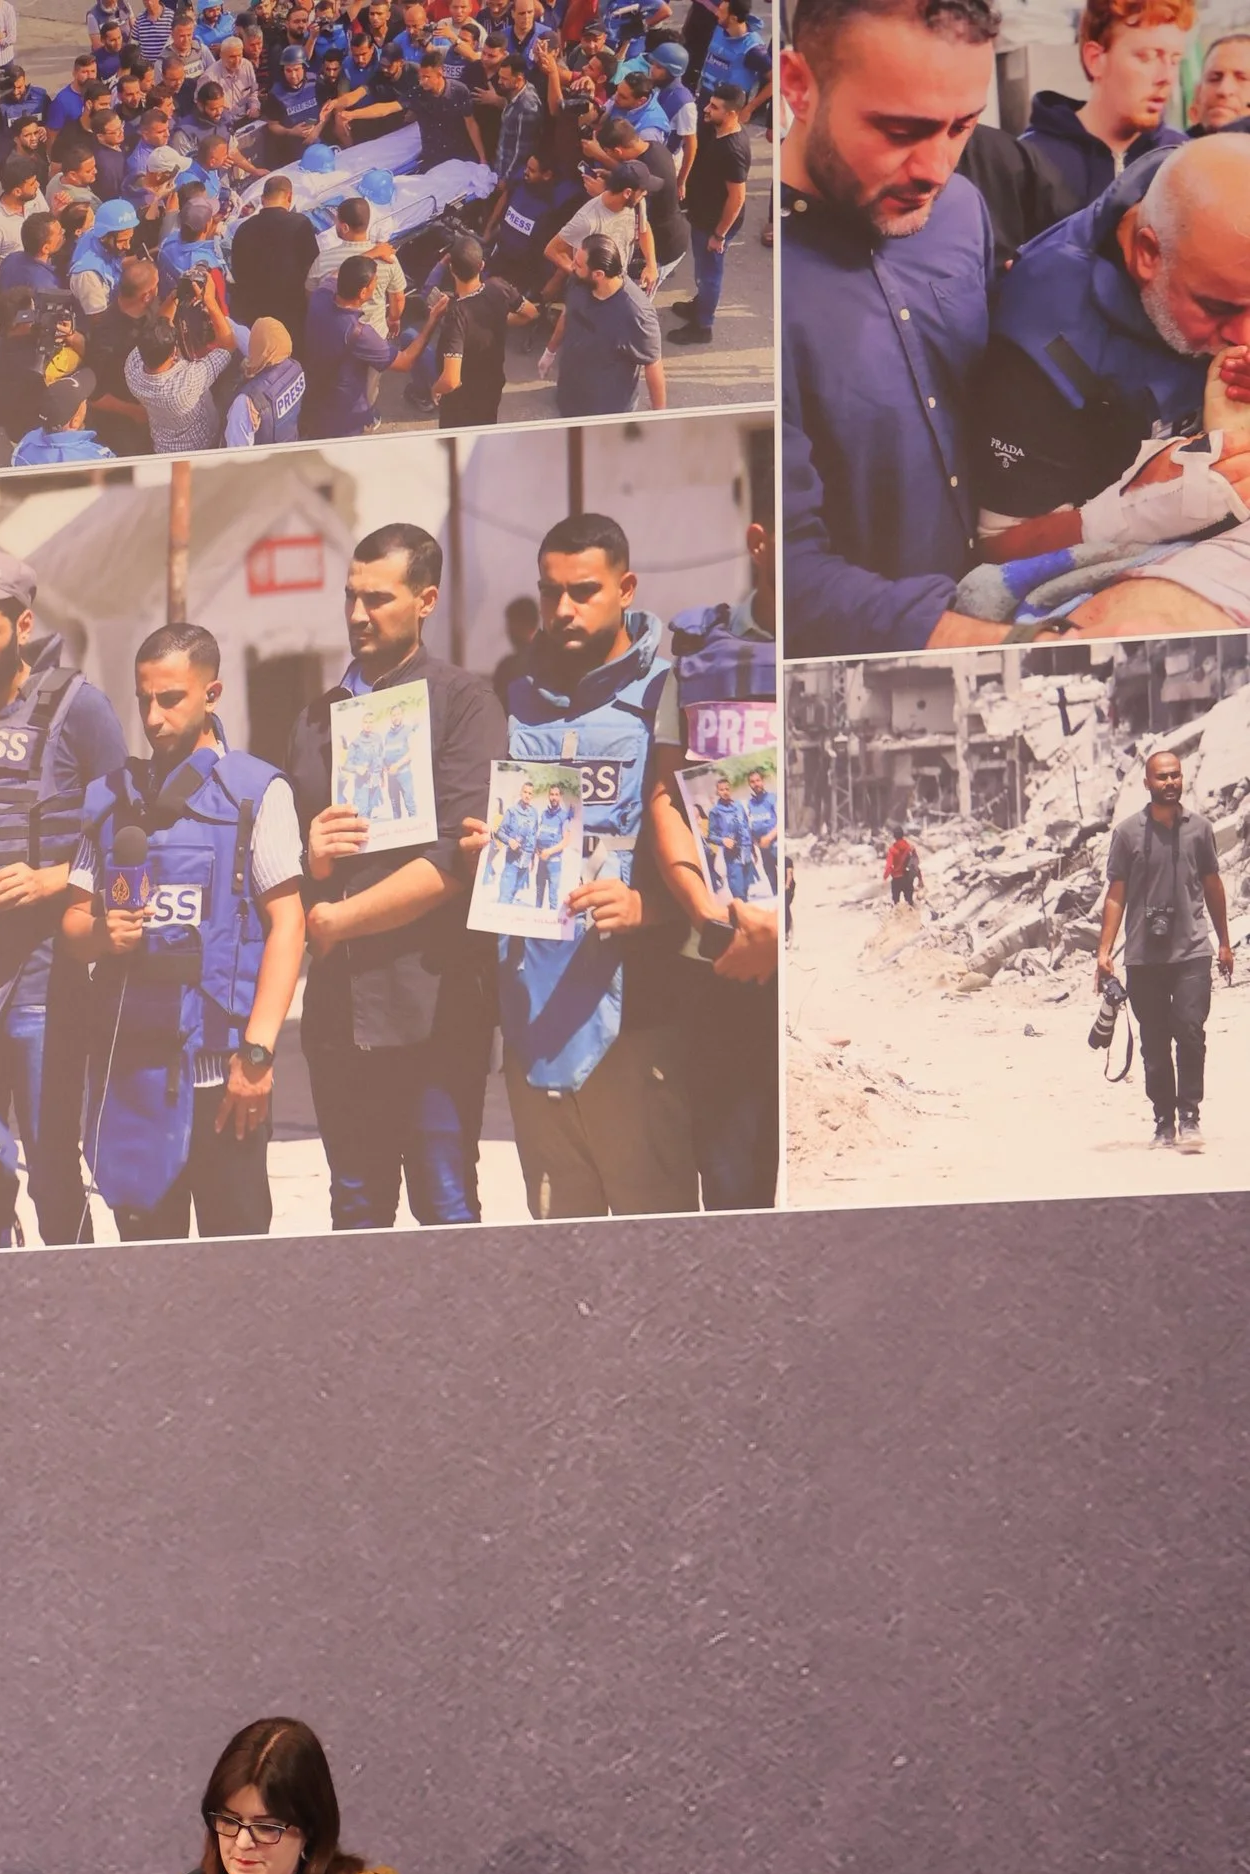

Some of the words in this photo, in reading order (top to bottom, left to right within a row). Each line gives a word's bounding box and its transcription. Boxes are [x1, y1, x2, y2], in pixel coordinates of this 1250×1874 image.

[507, 210, 531, 231] PRESS
[277, 376, 304, 416] PRESS
[991, 437, 1025, 456] PRADA
